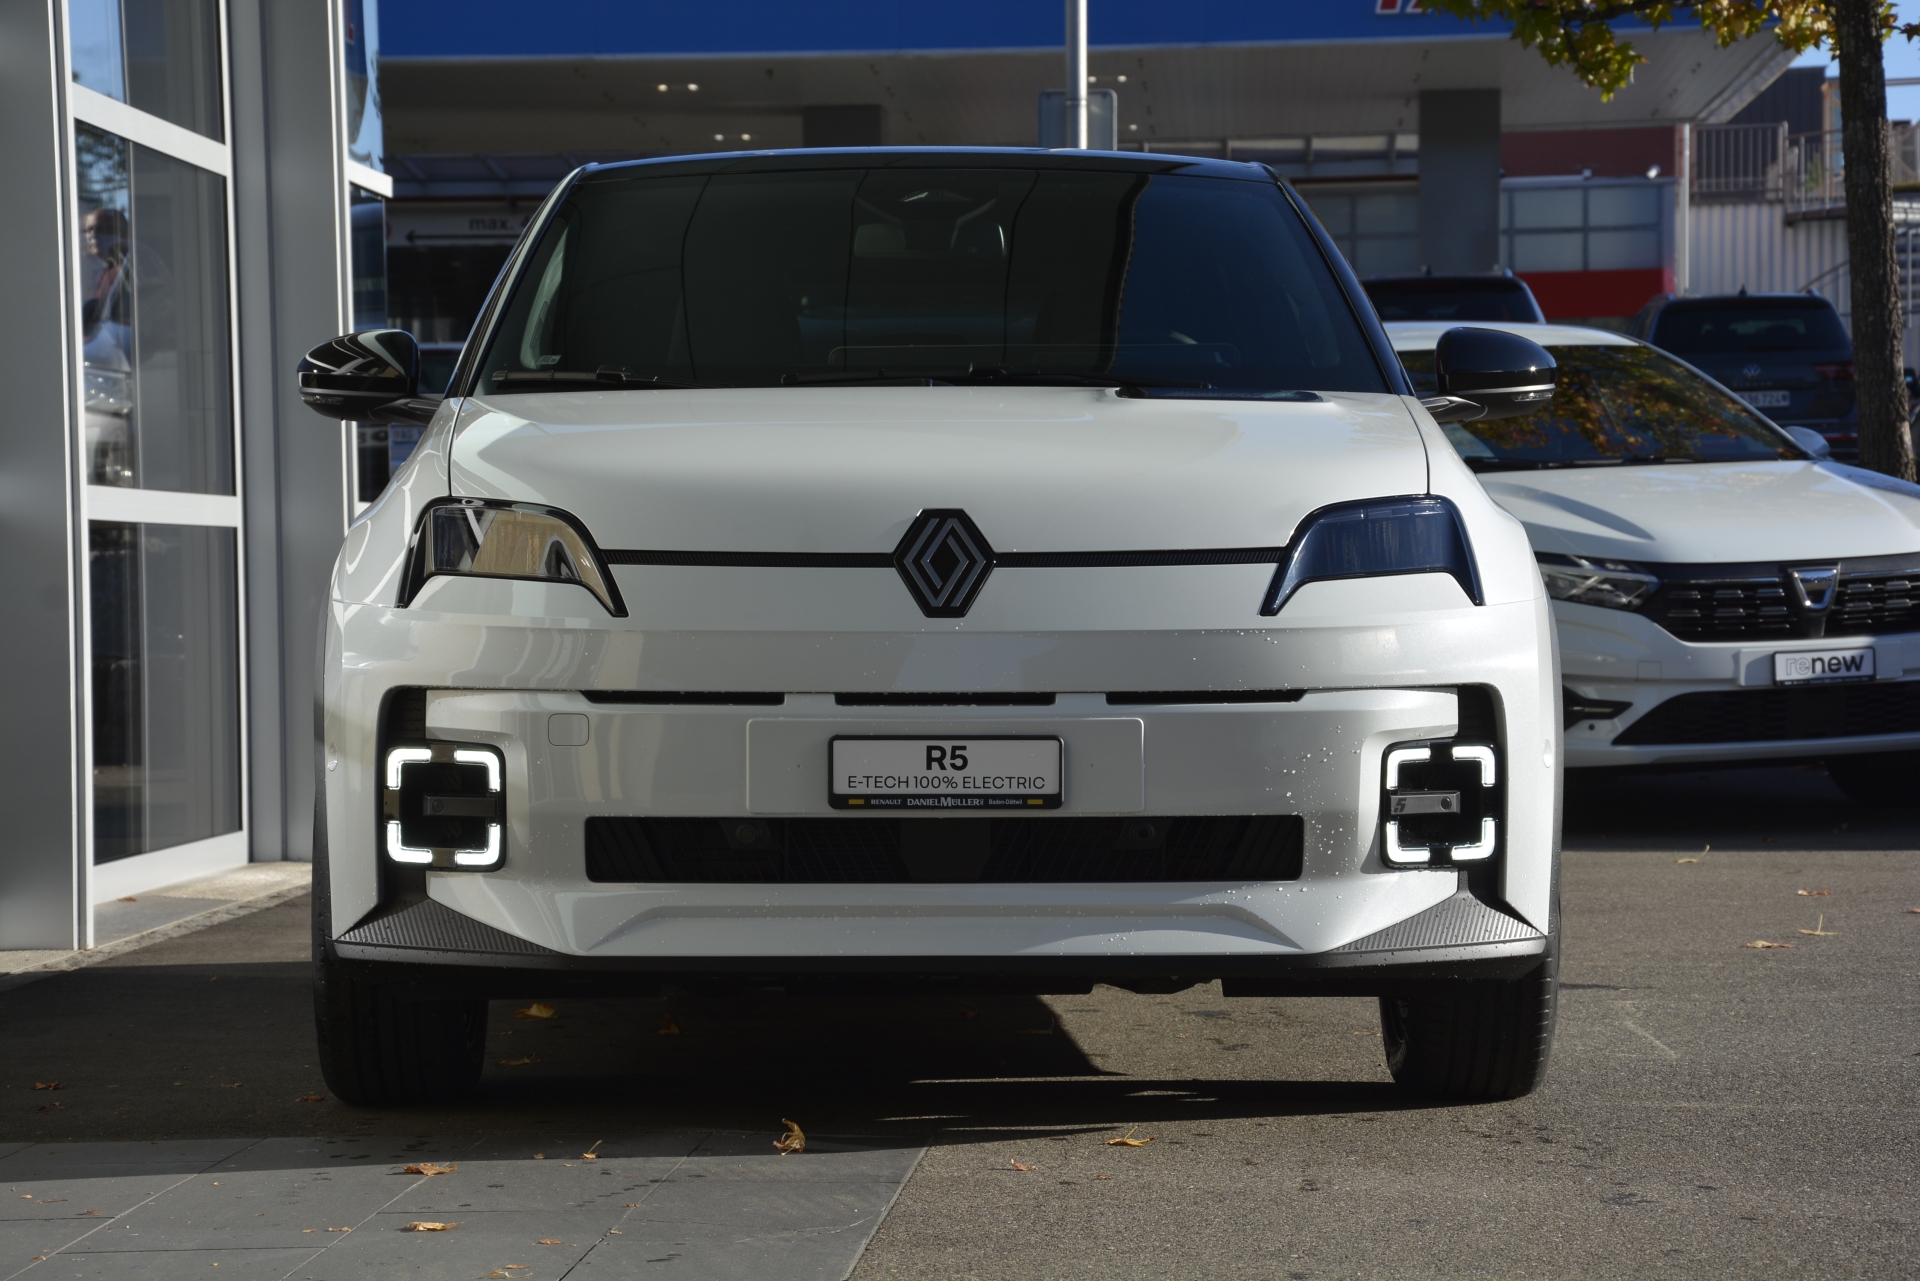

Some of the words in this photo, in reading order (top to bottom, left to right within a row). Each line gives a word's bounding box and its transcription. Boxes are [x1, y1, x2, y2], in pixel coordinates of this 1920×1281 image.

[468, 218, 514, 230] max.
[1785, 655, 1865, 676] renew
[925, 745, 969, 771] R5
[847, 775, 910, 790] E-TECH
[912, 775, 959, 790] 100%
[962, 775, 1046, 790] ELECTRIC
[870, 798, 902, 806] RENAULT
